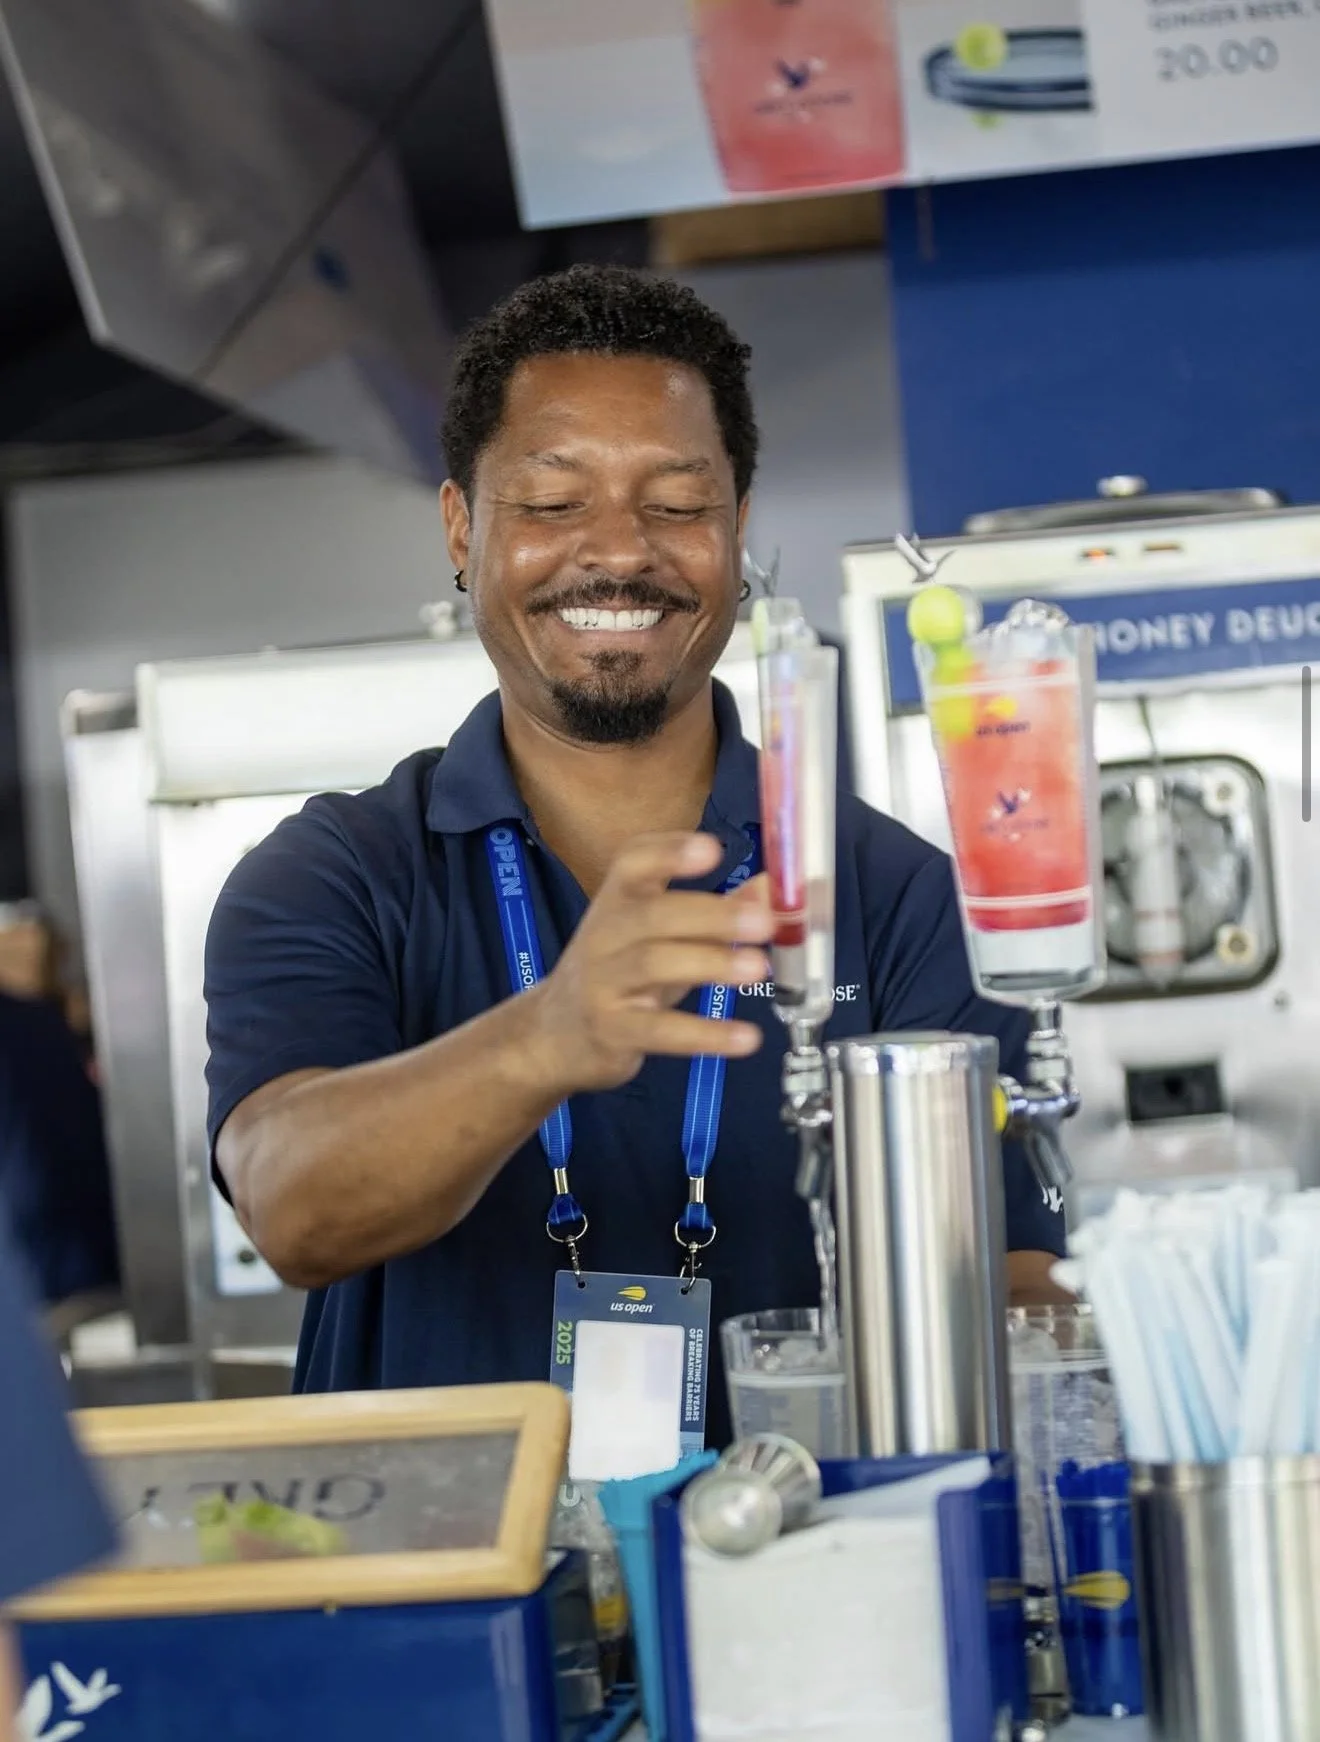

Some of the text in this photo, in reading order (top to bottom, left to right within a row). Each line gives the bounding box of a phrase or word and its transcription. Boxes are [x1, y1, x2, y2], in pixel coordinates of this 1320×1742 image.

[1155, 36, 1280, 82] 20.00
[489, 827, 523, 897] OPEN
[738, 982, 776, 998] GRE
[610, 1302, 654, 1315] us open
[556, 1321, 573, 1366] 2025
[684, 1327, 696, 1422] OF BREAKING BARRIERS
[692, 1328, 704, 1422] CELEBRATING 75 YEARS
